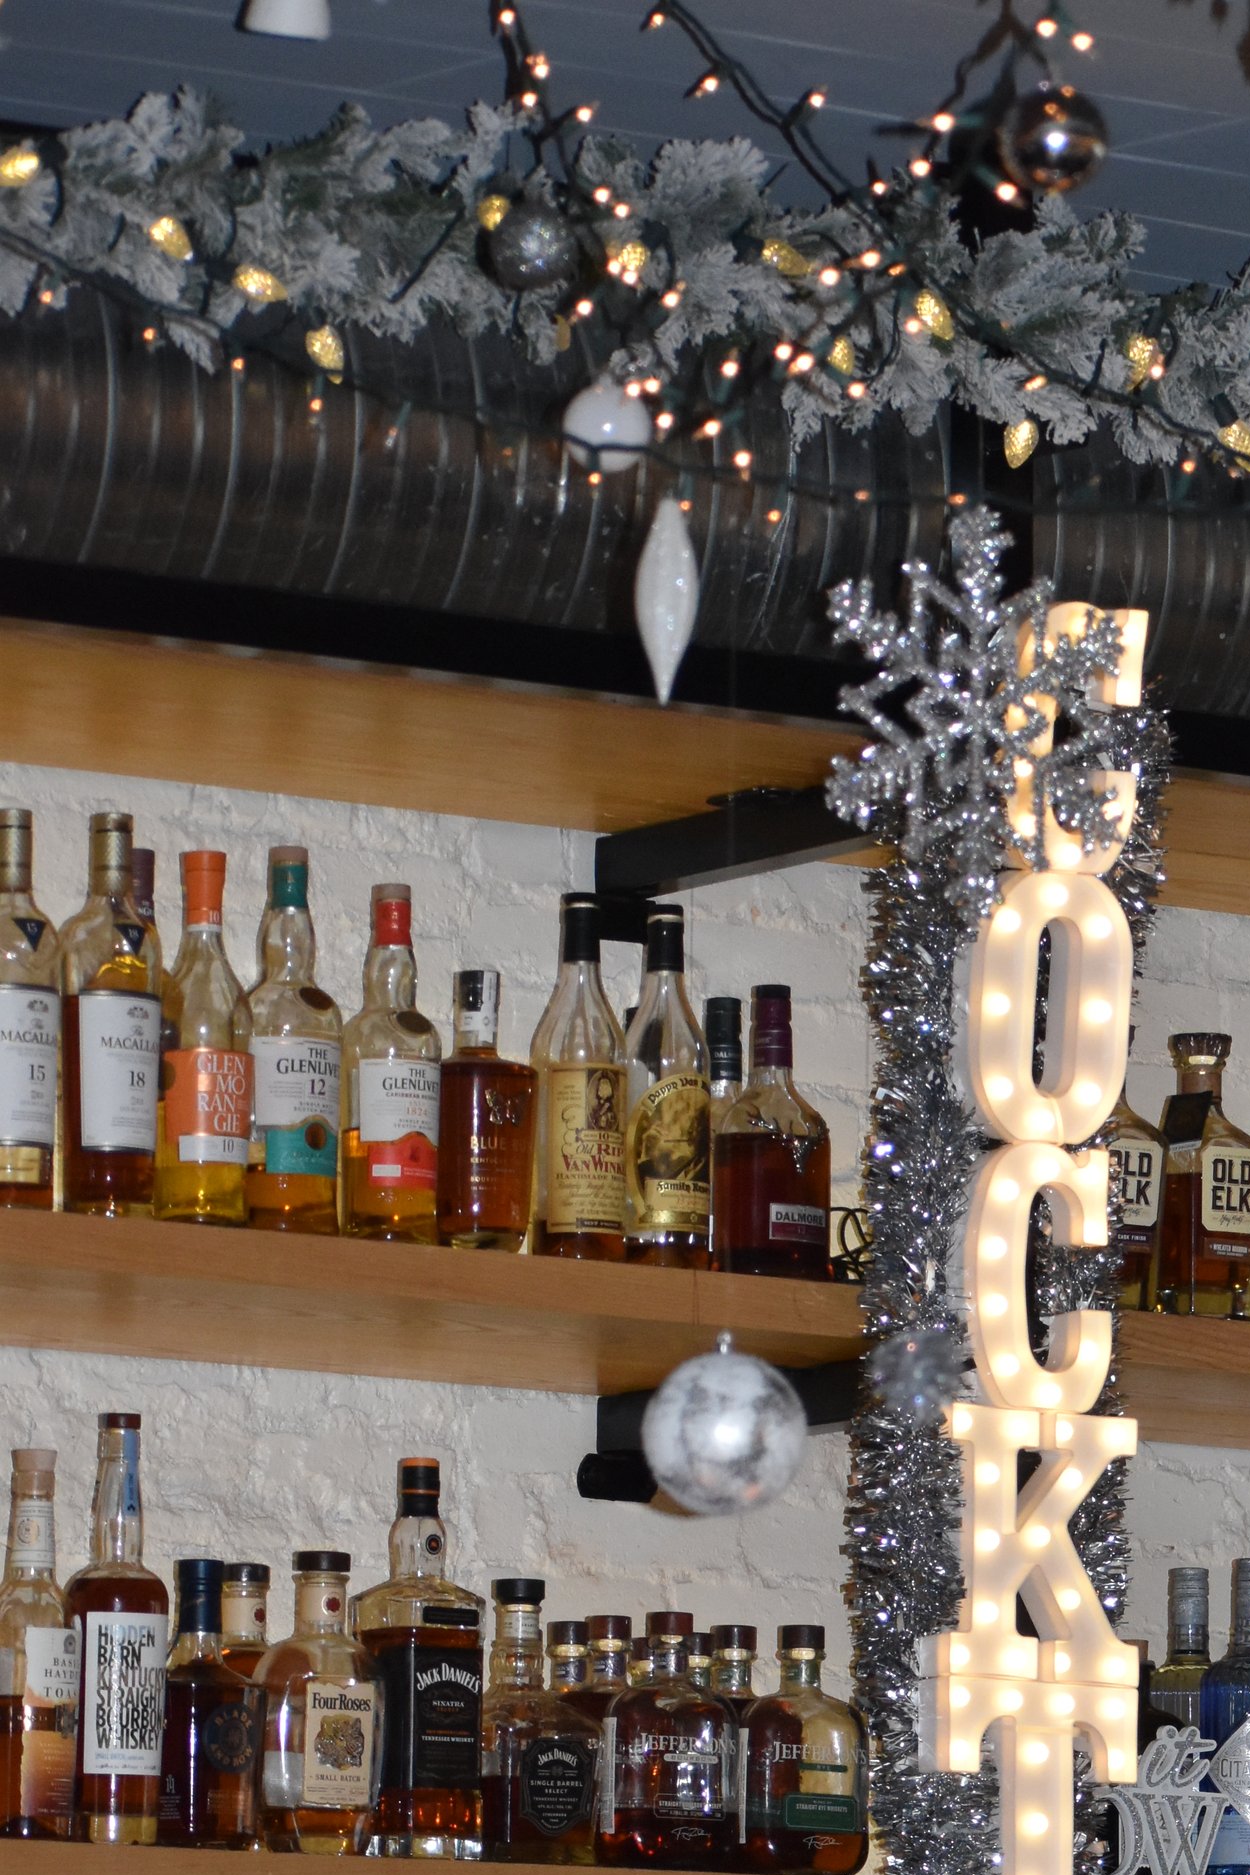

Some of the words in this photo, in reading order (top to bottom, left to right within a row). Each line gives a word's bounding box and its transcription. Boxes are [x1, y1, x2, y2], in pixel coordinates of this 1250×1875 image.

[308, 1048, 328, 1060] THE
[28, 1064, 46, 1082] 15
[197, 1055, 246, 1075] GLEN
[409, 1068, 426, 1078] THE
[130, 1070, 146, 1088] 18
[216, 1074, 246, 1095] MO
[310, 1078, 326, 1096] 12
[198, 1092, 236, 1112] RAN
[213, 1112, 240, 1134] GIE
[222, 1138, 234, 1154] 10
[597, 1143, 624, 1158] RIP
[563, 1154, 590, 1172] VAN
[775, 1211, 824, 1226] DALMORE
[98, 1624, 156, 1648] HIDDEN
[98, 1646, 142, 1670] BARN
[97, 1666, 166, 1690] KENTUCKY
[416, 1667, 440, 1691] JACK
[442, 1662, 482, 1694] DANIEL'S
[96, 1687, 162, 1708] STRAIGHT
[312, 1692, 339, 1710] Four
[339, 1694, 372, 1712] Roses
[432, 1700, 464, 1708] SINATRA
[96, 1704, 163, 1730] BOURBON
[214, 1711, 252, 1728] BLADE
[96, 1728, 160, 1750] WHISKEY
[451, 1736, 474, 1744] WHISKEY
[640, 1732, 736, 1756] JEFFERSON'S
[538, 1750, 554, 1766] JACK
[554, 1748, 578, 1767] DANIEL'S
[772, 1741, 866, 1765] JEFFERSON'S
[315, 1774, 338, 1782] SMALL
[340, 1774, 361, 1782] BATCH
